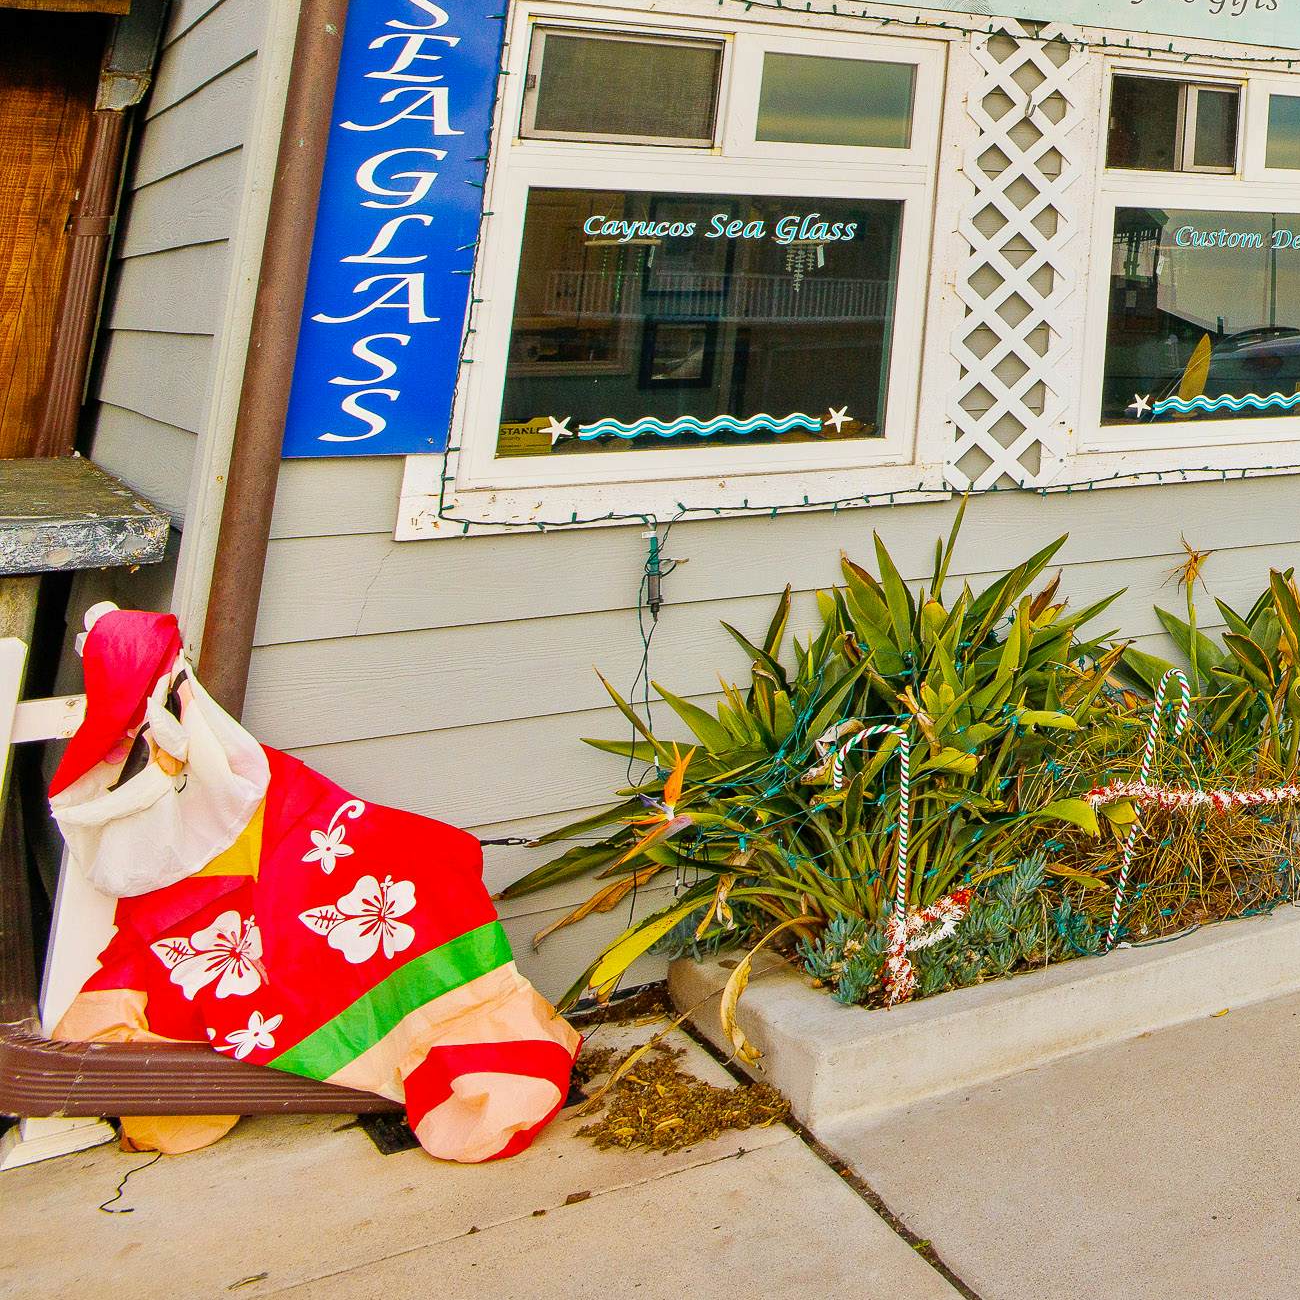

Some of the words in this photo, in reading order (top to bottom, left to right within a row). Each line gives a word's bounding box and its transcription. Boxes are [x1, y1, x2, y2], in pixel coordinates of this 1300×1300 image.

[583, 215, 697, 243] Cayucos
[704, 213, 766, 239] Sea
[775, 212, 858, 245] Glass
[1175, 225, 1264, 248] Custom
